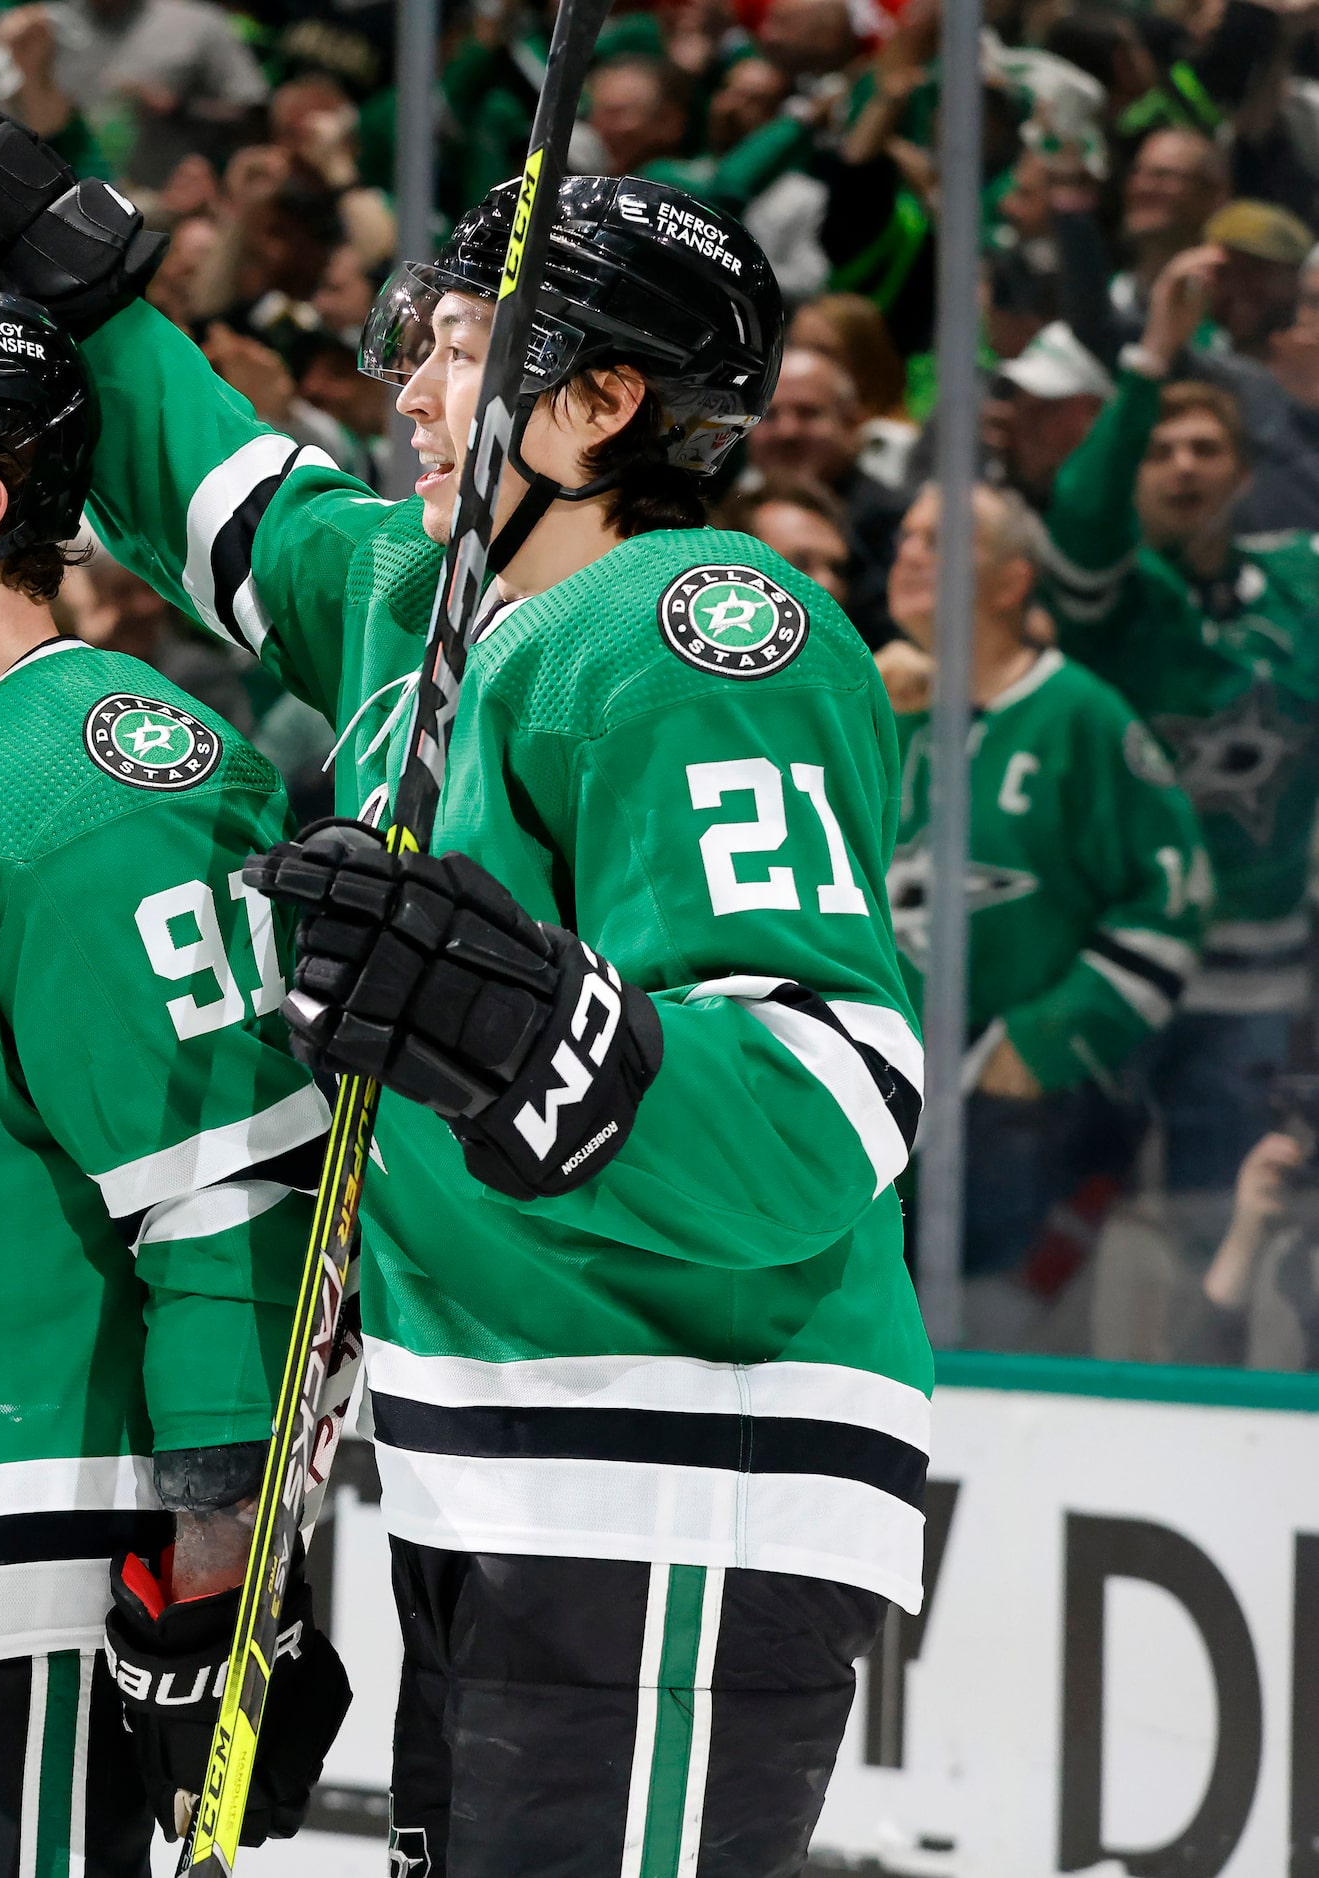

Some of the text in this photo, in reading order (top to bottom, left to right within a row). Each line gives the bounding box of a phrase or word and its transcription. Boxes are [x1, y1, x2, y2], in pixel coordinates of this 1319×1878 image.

[504, 171, 536, 282] CCM
[655, 216, 743, 277] TRANSFER
[658, 202, 730, 246] ENERGY
[672, 571, 787, 614] DALLAS
[688, 627, 794, 667] STARS
[96, 700, 195, 743] DALLAS
[119, 743, 211, 780] STARS
[998, 751, 1040, 815] C
[685, 757, 871, 917] 21
[134, 869, 287, 1041] 91
[336, 1076, 377, 1248] SUPER
[560, 1120, 619, 1176] ROBERTSON
[282, 1248, 349, 1523] TACKS
[201, 1726, 232, 1838] CCM
